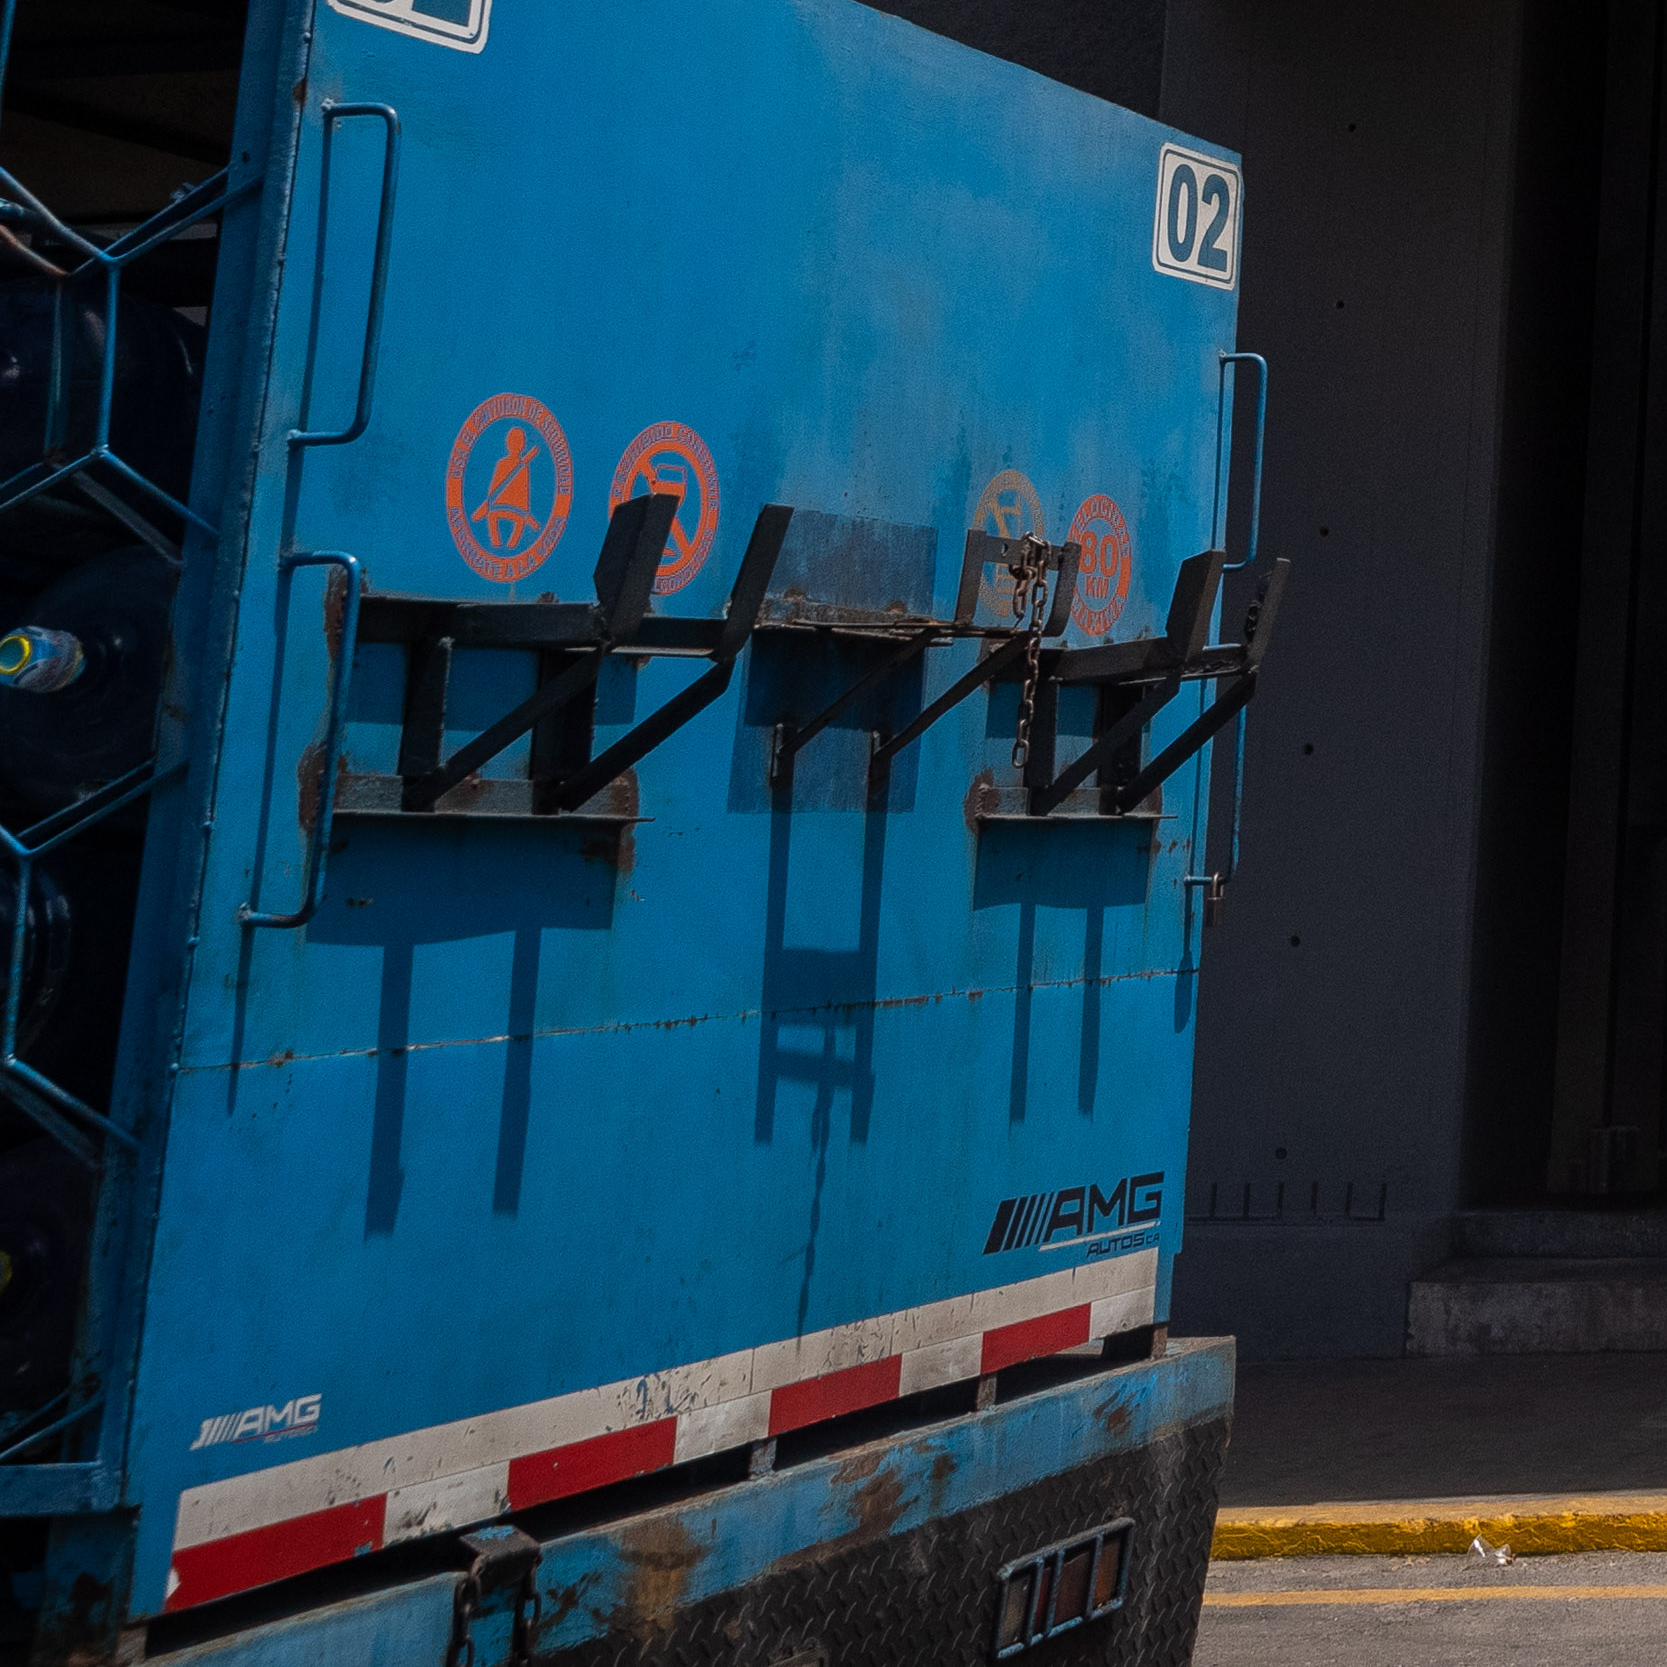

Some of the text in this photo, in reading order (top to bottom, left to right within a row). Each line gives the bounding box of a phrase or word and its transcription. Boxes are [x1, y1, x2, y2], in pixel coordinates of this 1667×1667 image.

[1167, 163, 1230, 272] 02
[1080, 531, 1118, 577] 80
[1084, 575, 1109, 599] KM
[1043, 1171, 1164, 1242] AMG
[1086, 1232, 1145, 1258] AUTOS
[232, 1393, 322, 1439] AMG
